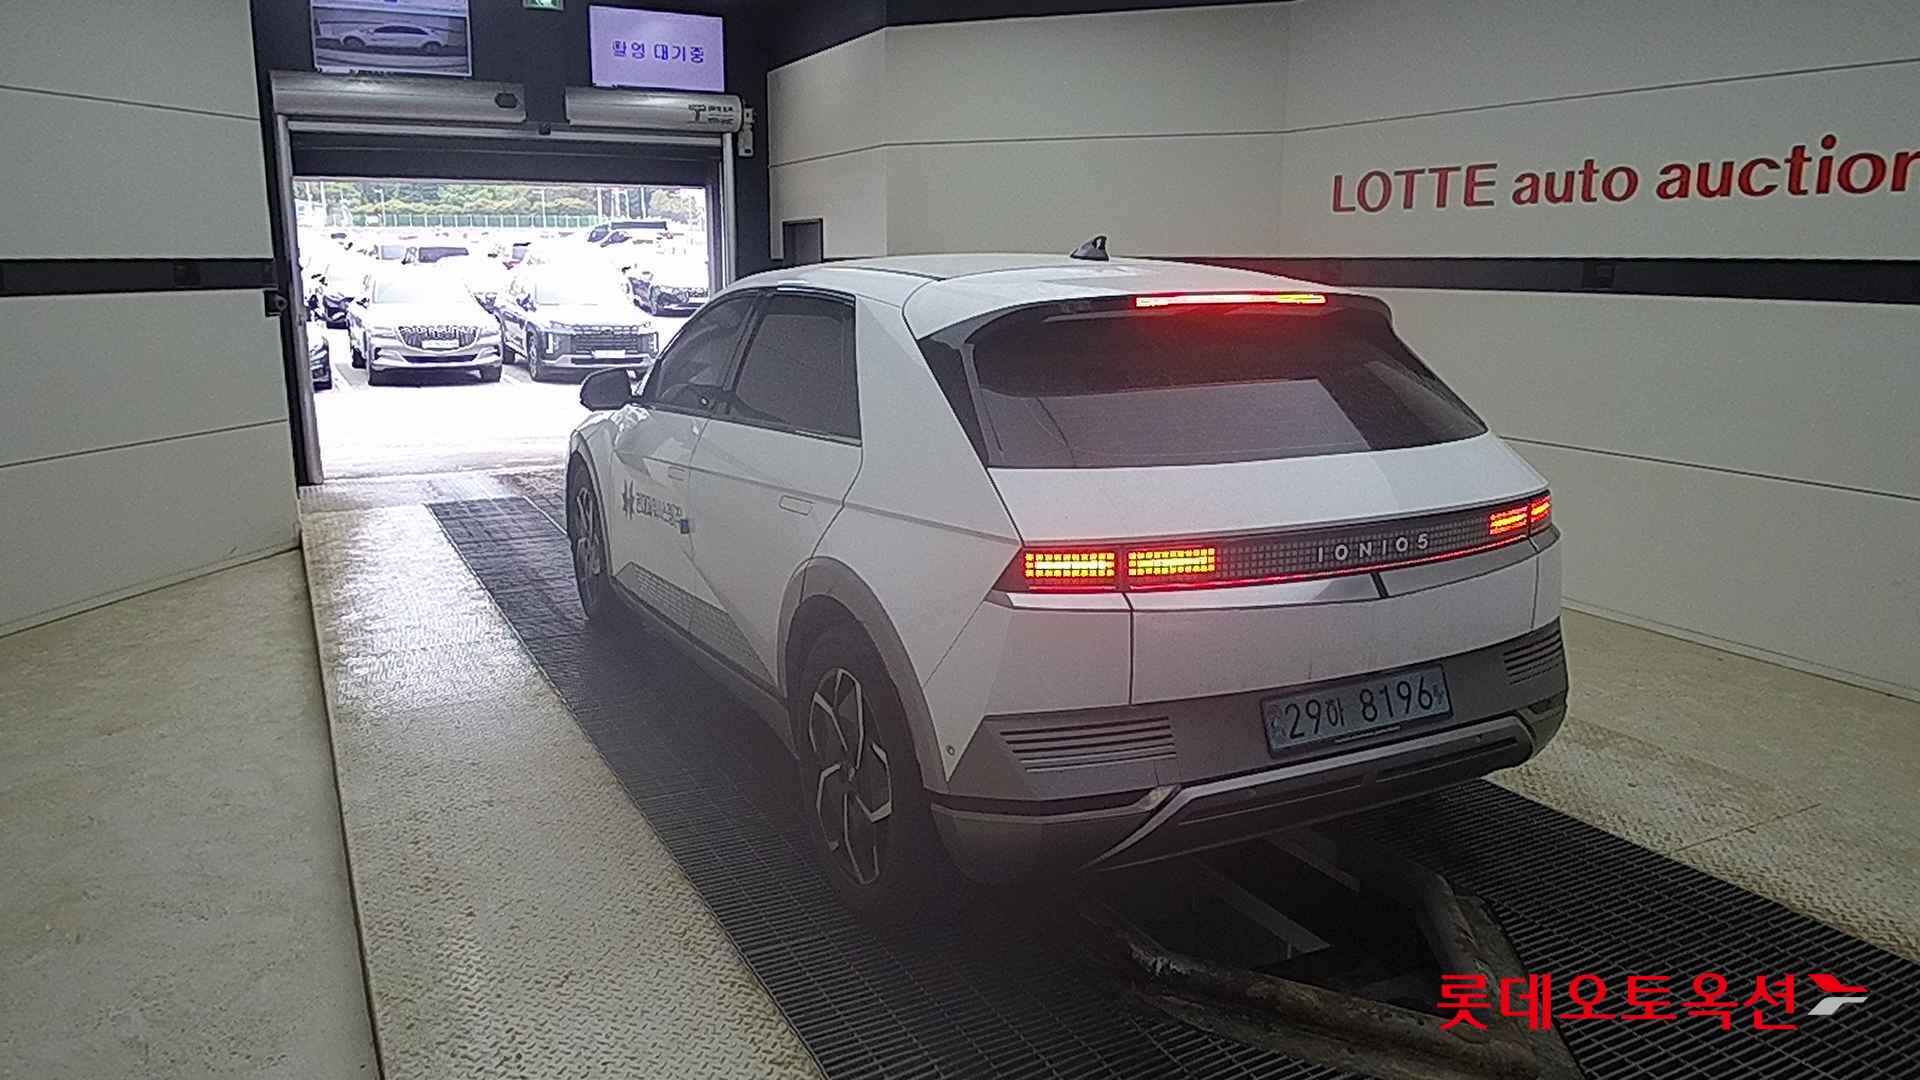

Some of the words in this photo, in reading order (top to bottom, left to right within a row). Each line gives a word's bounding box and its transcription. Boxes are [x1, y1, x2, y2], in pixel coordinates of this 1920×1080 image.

[655, 44, 704, 63] 대기중
[1332, 162, 1498, 213] LOTTE
[1512, 159, 1639, 205] auto
[1360, 676, 1434, 722] 8196
